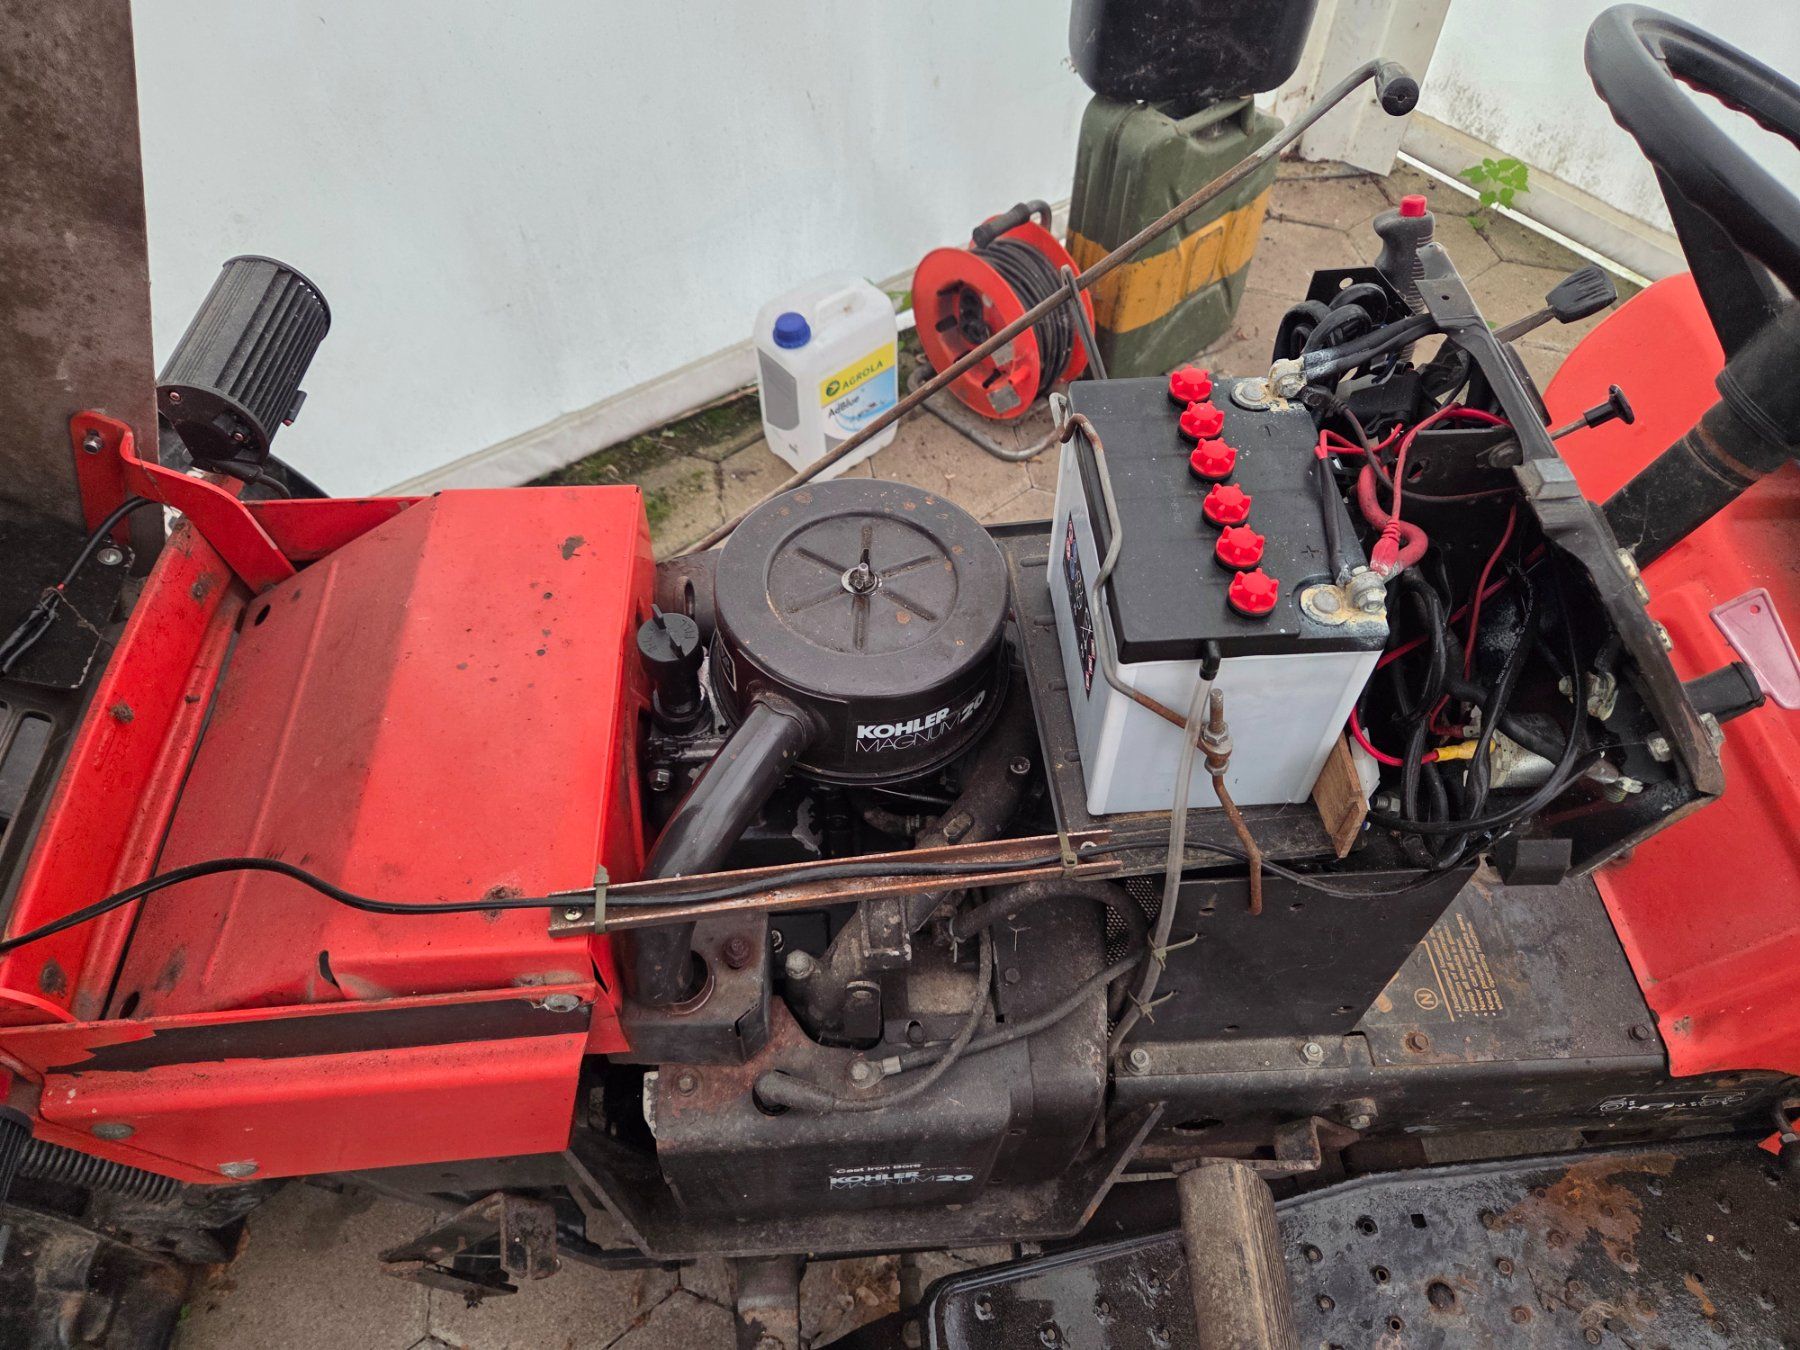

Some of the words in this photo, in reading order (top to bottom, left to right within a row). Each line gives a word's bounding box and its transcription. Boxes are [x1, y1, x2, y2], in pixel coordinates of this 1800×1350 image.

[843, 360, 884, 390] AGROLA
[856, 711, 961, 752] MAGNUM
[960, 689, 986, 723] 20
[857, 707, 950, 739] KOHLER
[830, 1171, 919, 1185] KOHLER
[936, 1174, 974, 1182] 20
